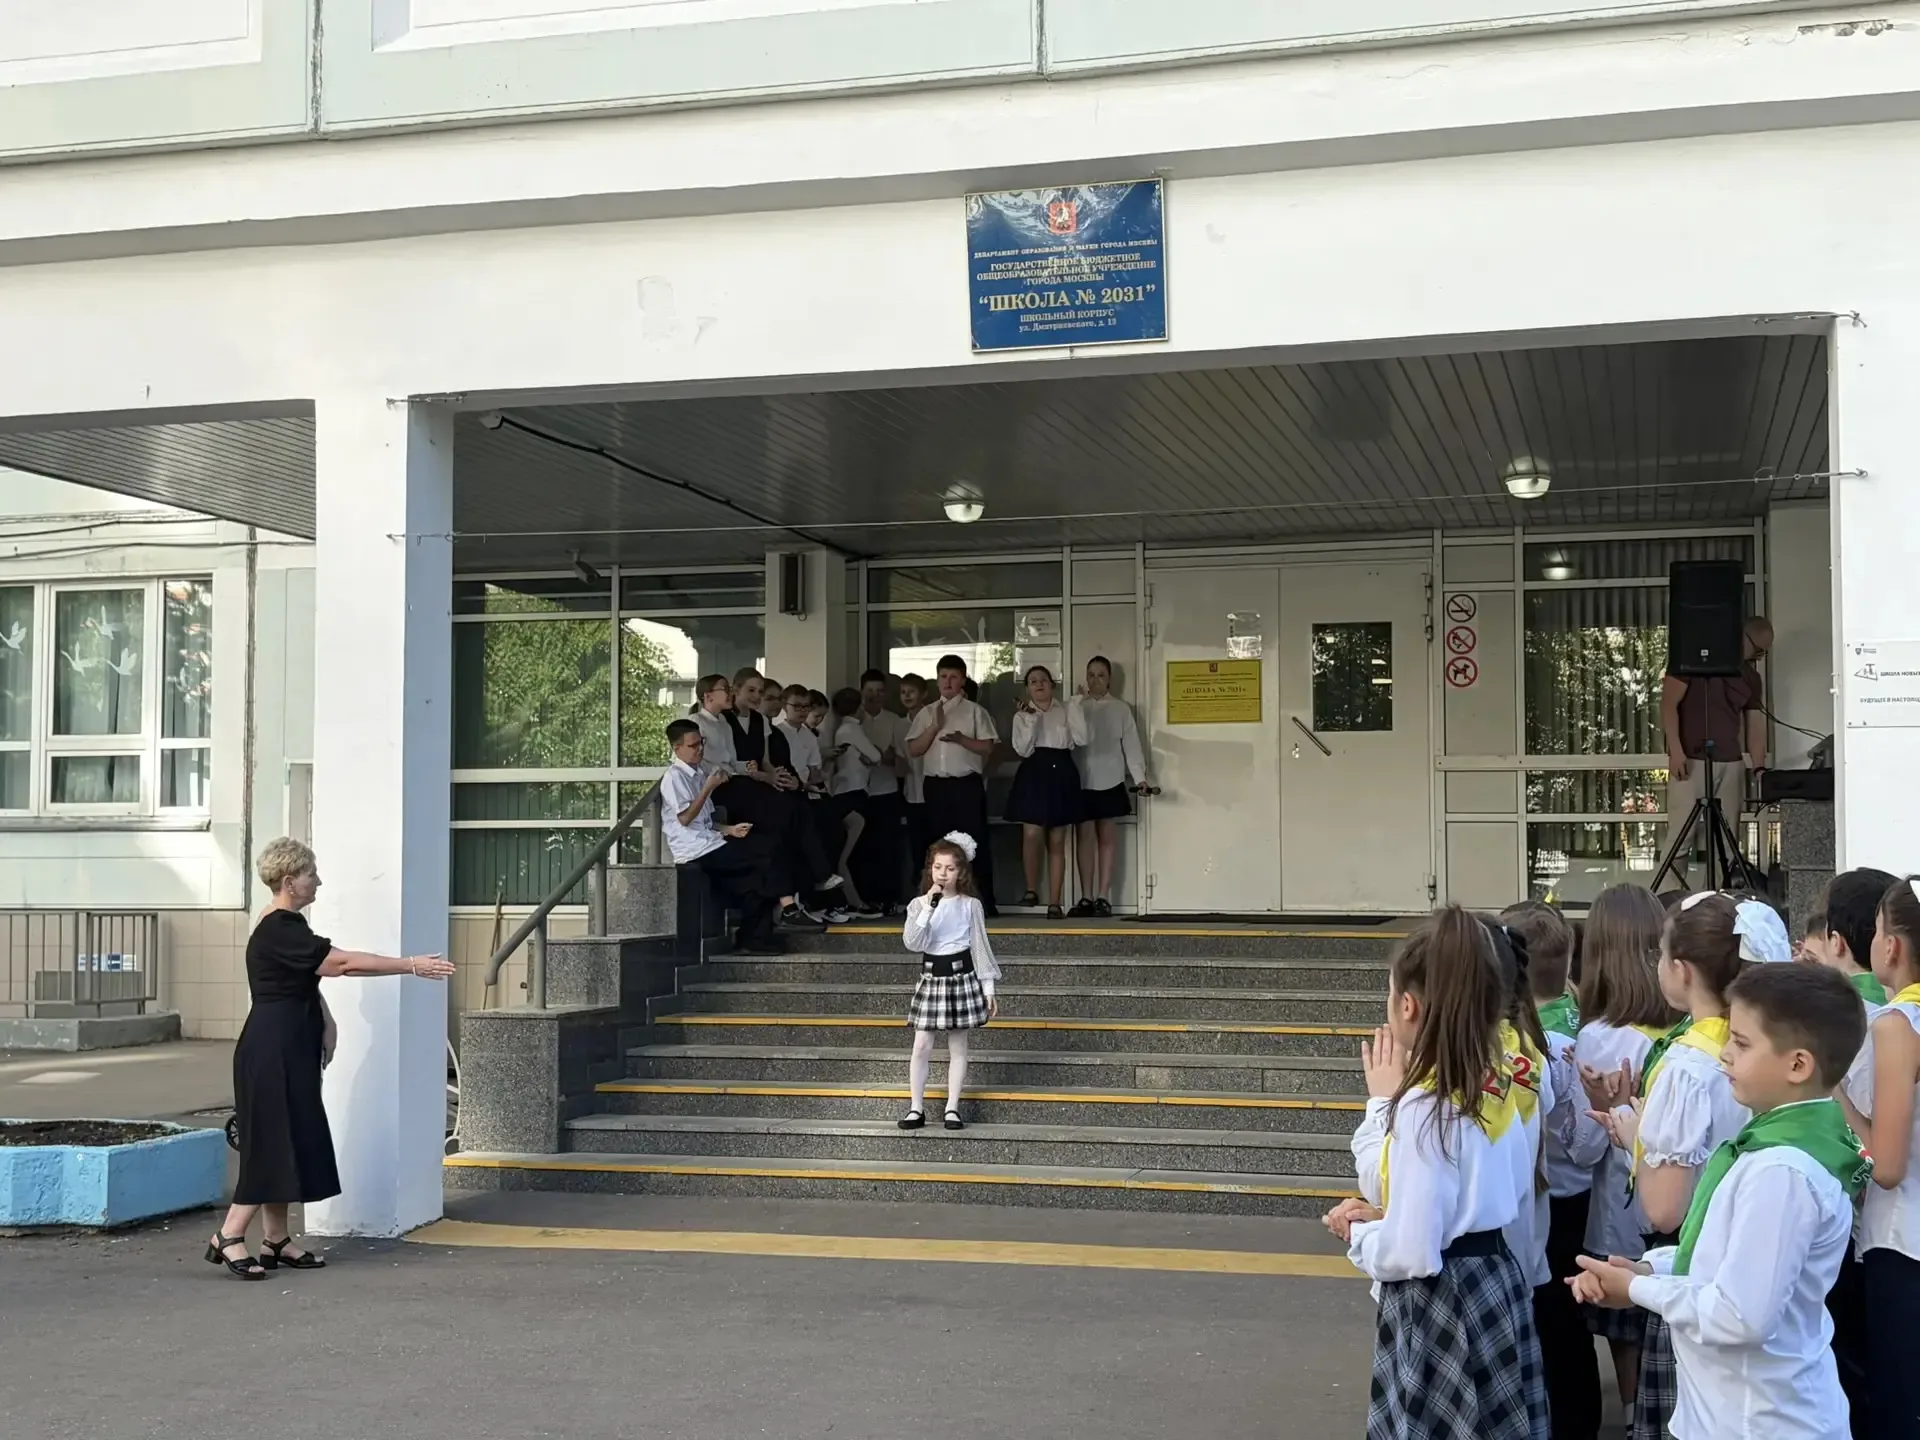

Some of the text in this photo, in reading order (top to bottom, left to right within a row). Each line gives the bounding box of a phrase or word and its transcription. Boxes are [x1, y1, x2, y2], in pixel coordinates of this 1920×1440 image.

[1101, 241, 1126, 249] ГОРОДА
[990, 252, 1141, 271] ГОСУДАРСТВЕННОЕ БЮДЖЕТНОЕ
[976, 260, 1157, 281] ОБЩЕОБРАЗОВАТЕЛЬНОЕ УЧРЕЖДЕНИЕ
[1026, 273, 1105, 286] ГОРОДА МОСКВЫ
[1075, 288, 1096, 306] №
[1101, 284, 1156, 304] 2031”
[1020, 308, 1115, 323] ШКОЛЬНЫЙ КОРПУС
